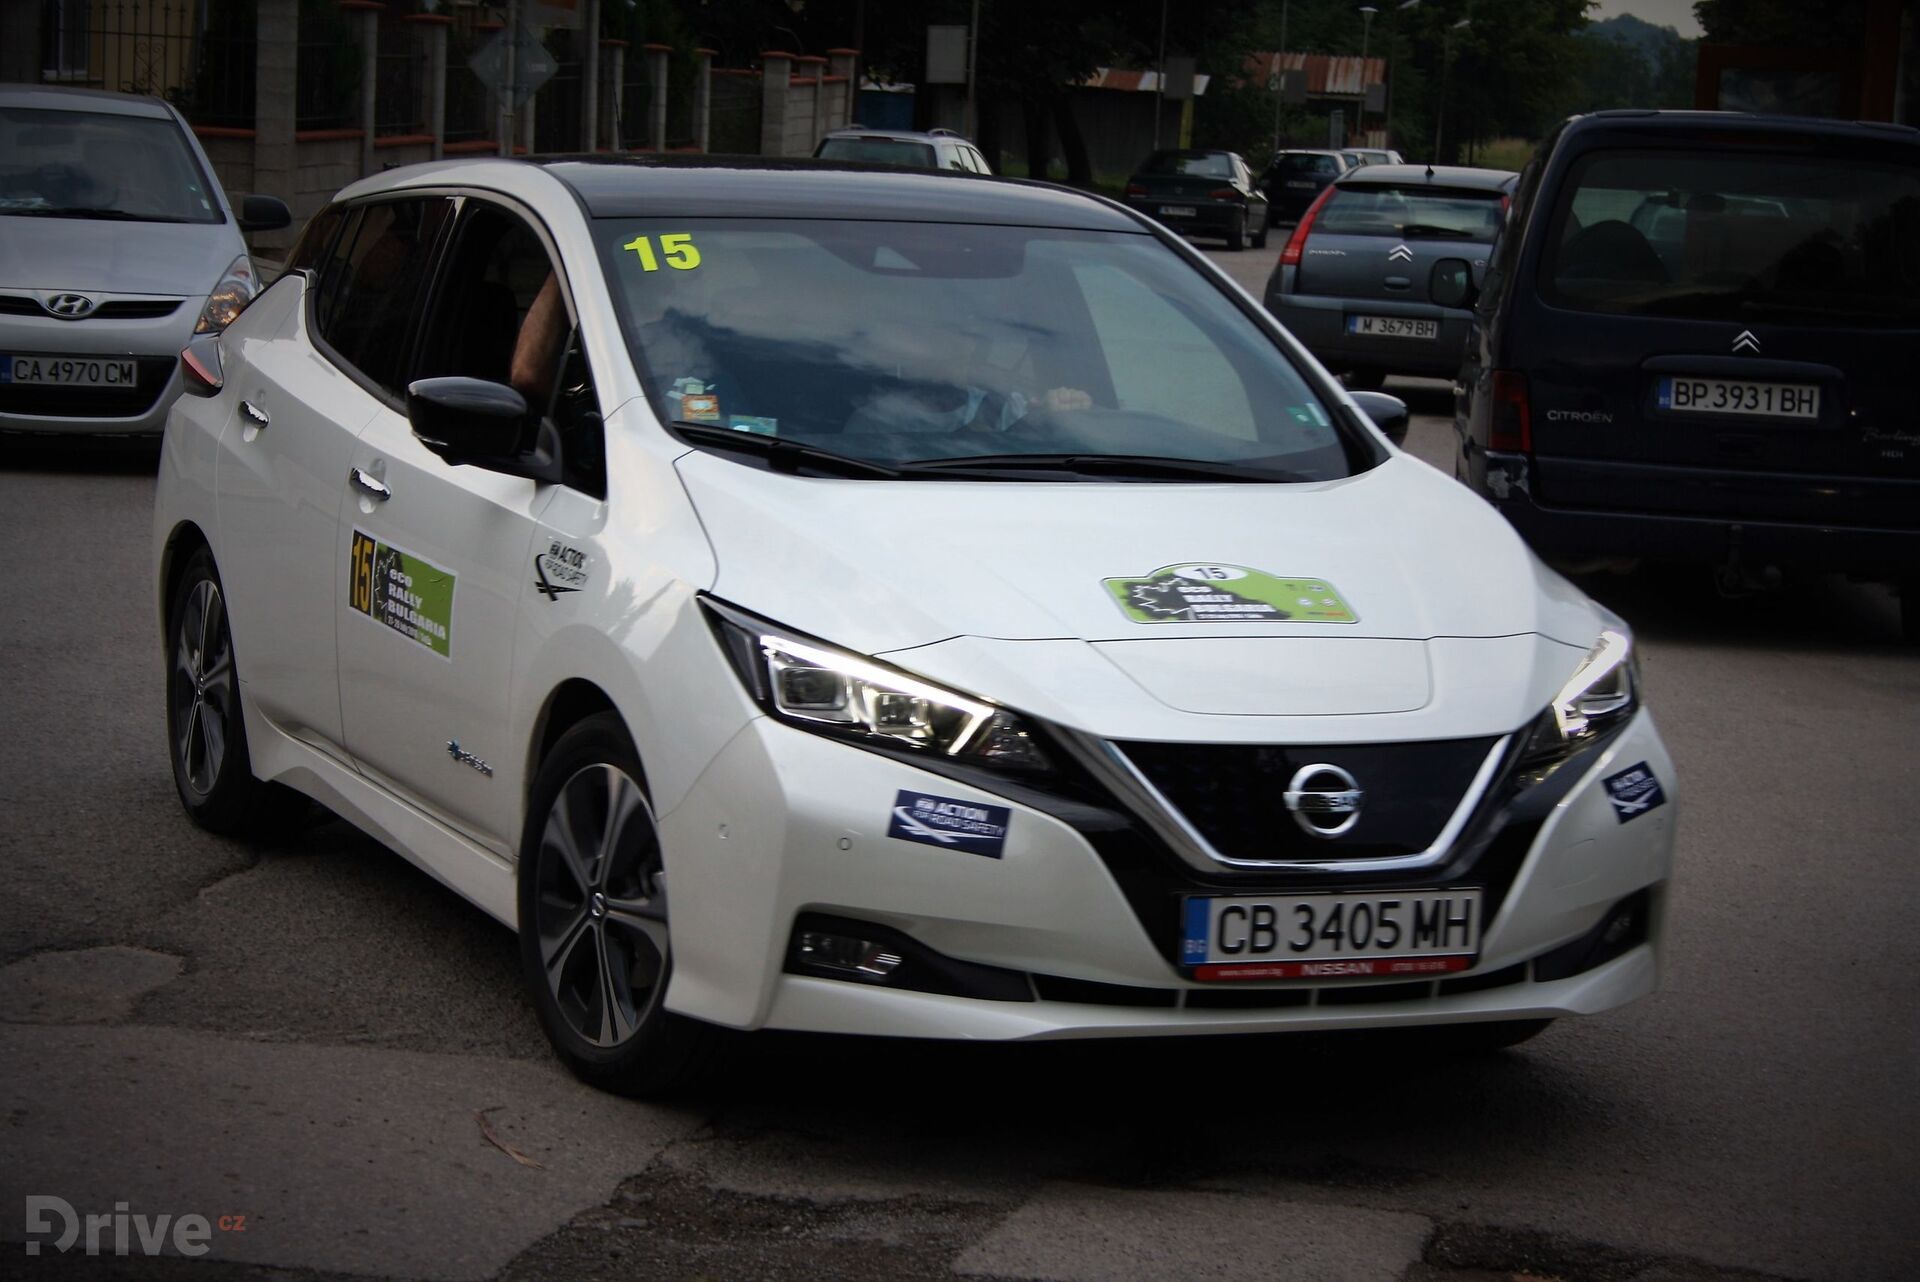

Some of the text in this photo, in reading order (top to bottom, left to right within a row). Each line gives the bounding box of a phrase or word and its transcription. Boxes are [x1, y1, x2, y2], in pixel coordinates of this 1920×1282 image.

[623, 233, 702, 272] 15
[1362, 318, 1373, 332] M
[1379, 319, 1413, 335] 3679
[1415, 321, 1435, 337] BH
[14, 360, 42, 380] CA
[48, 361, 100, 382] 4970
[105, 363, 133, 384] CM
[1675, 382, 1814, 413] BP 3931 BH
[353, 535, 374, 612] 15
[388, 568, 413, 588] eco
[1194, 567, 1227, 579] 15
[388, 583, 423, 609] RALLY
[387, 599, 446, 640] BULGARIA
[934, 803, 989, 822] ACTION
[929, 814, 961, 828] ROAD
[961, 820, 1005, 836] SAFETY
[1216, 903, 1278, 955] CB
[1289, 901, 1400, 953] 3405
[1411, 896, 1473, 949] MH
[1301, 961, 1375, 976] NISSAN
